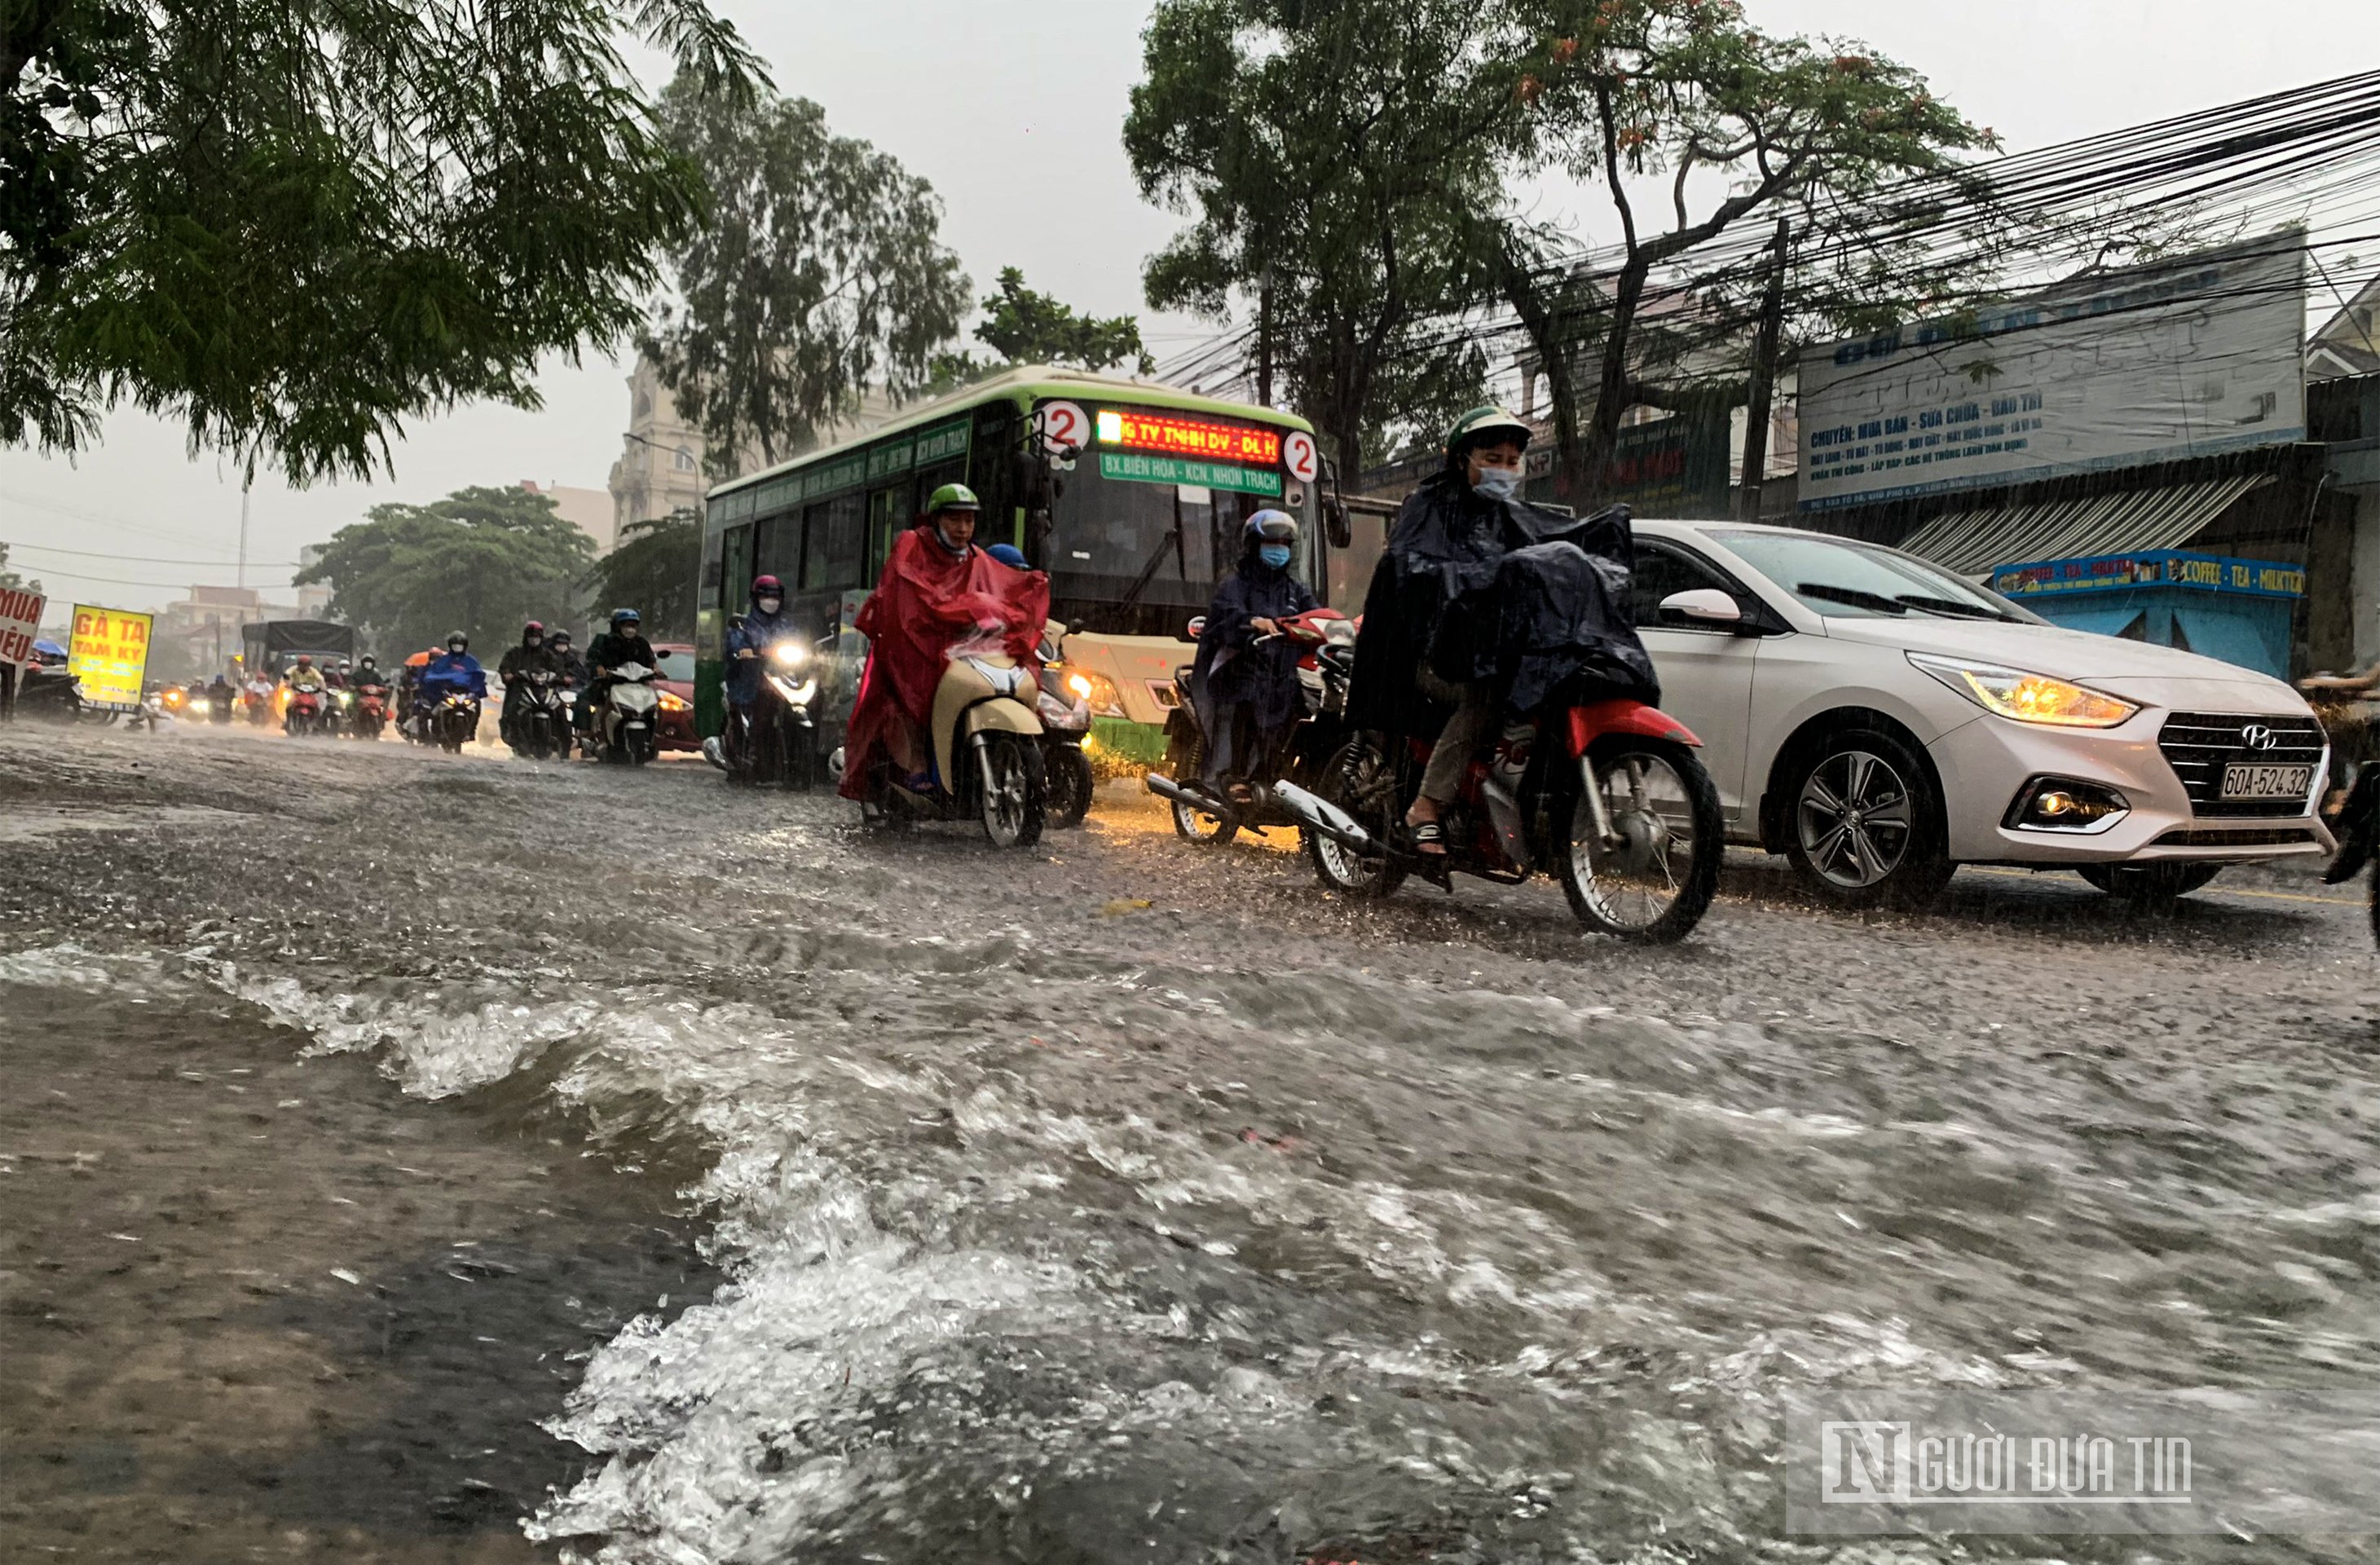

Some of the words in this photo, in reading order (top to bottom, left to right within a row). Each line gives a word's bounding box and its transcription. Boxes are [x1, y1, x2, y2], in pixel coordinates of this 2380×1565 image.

[1051, 409, 1076, 444] 2
[1139, 423, 1160, 442] TY
[1163, 426, 1205, 447] TNHH
[1858, 421, 1882, 440] MUA
[1885, 415, 1908, 434] BÁN
[1294, 439, 1312, 474] 2
[2184, 560, 2222, 585] COFFEE
[2231, 565, 2250, 588] TEA
[2259, 568, 2304, 593] MILKTEA
[0, 588, 40, 624] MUA
[75, 611, 108, 639] GÀ
[119, 619, 146, 644] TA
[2224, 768, 2307, 796] 60A-524.32
